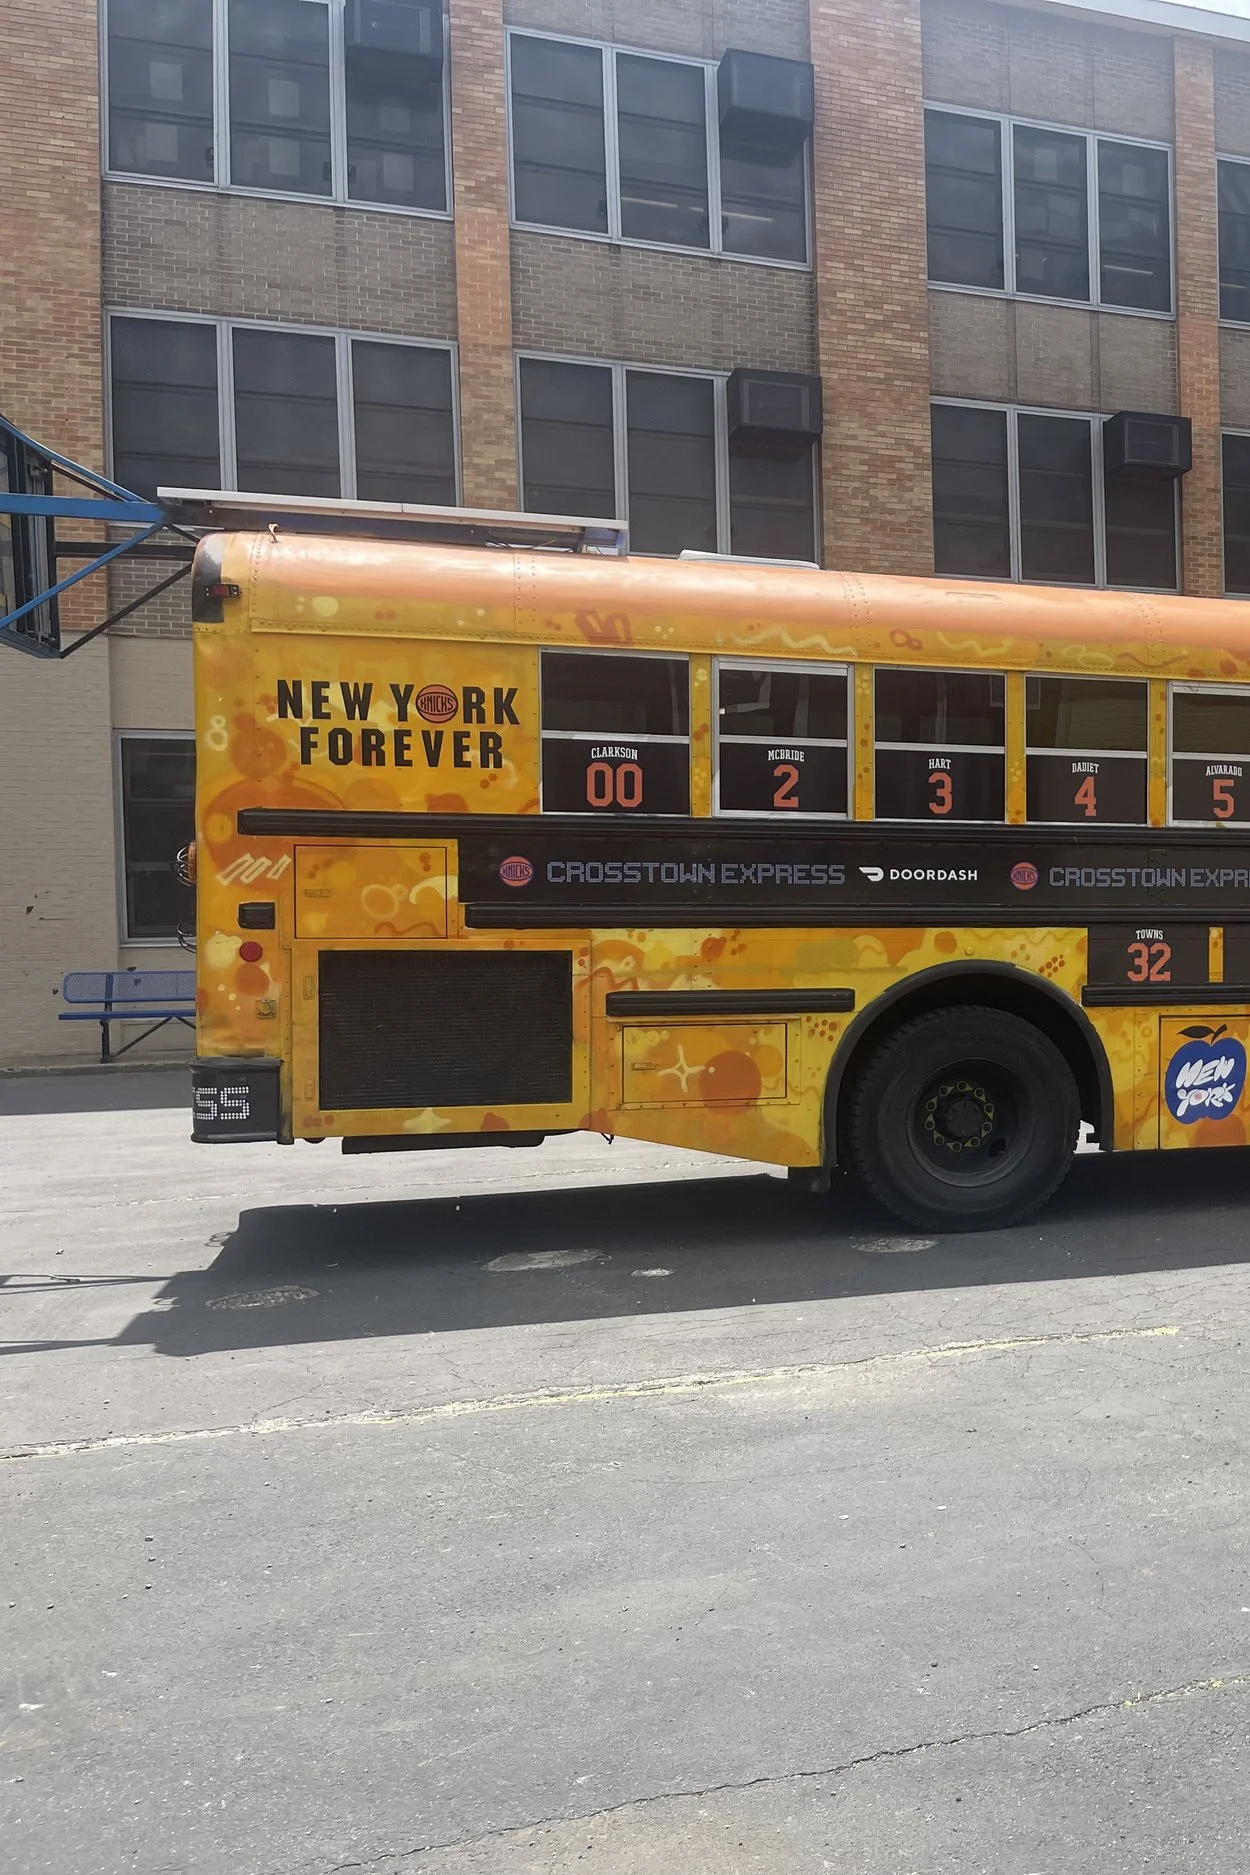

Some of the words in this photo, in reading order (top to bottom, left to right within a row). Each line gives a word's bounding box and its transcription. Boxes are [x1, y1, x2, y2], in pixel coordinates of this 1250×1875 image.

[276, 679, 373, 721] NEW
[419, 694, 454, 713] KNICKS
[300, 726, 503, 769] FOREVER
[590, 746, 638, 761] CLARKSON
[767, 749, 805, 762] MCBRIDE
[928, 758, 952, 770] HART
[1071, 762, 1100, 775] DADIET
[1205, 764, 1243, 777] ALVARADO
[586, 761, 644, 808] 00
[773, 763, 799, 808] 2
[928, 771, 953, 815] 3
[1074, 775, 1097, 817] 4
[1212, 778, 1235, 819] 5
[502, 863, 531, 880] KNICKS
[547, 861, 716, 884] CROSSTOWN
[721, 863, 846, 885] EXPRESS
[889, 868, 978, 881] DOORDASH
[1050, 867, 1186, 887] CROSSTOWN
[1135, 928, 1164, 940] TOWNS
[1127, 941, 1172, 983] 32
[1175, 1055, 1235, 1089] NEW
